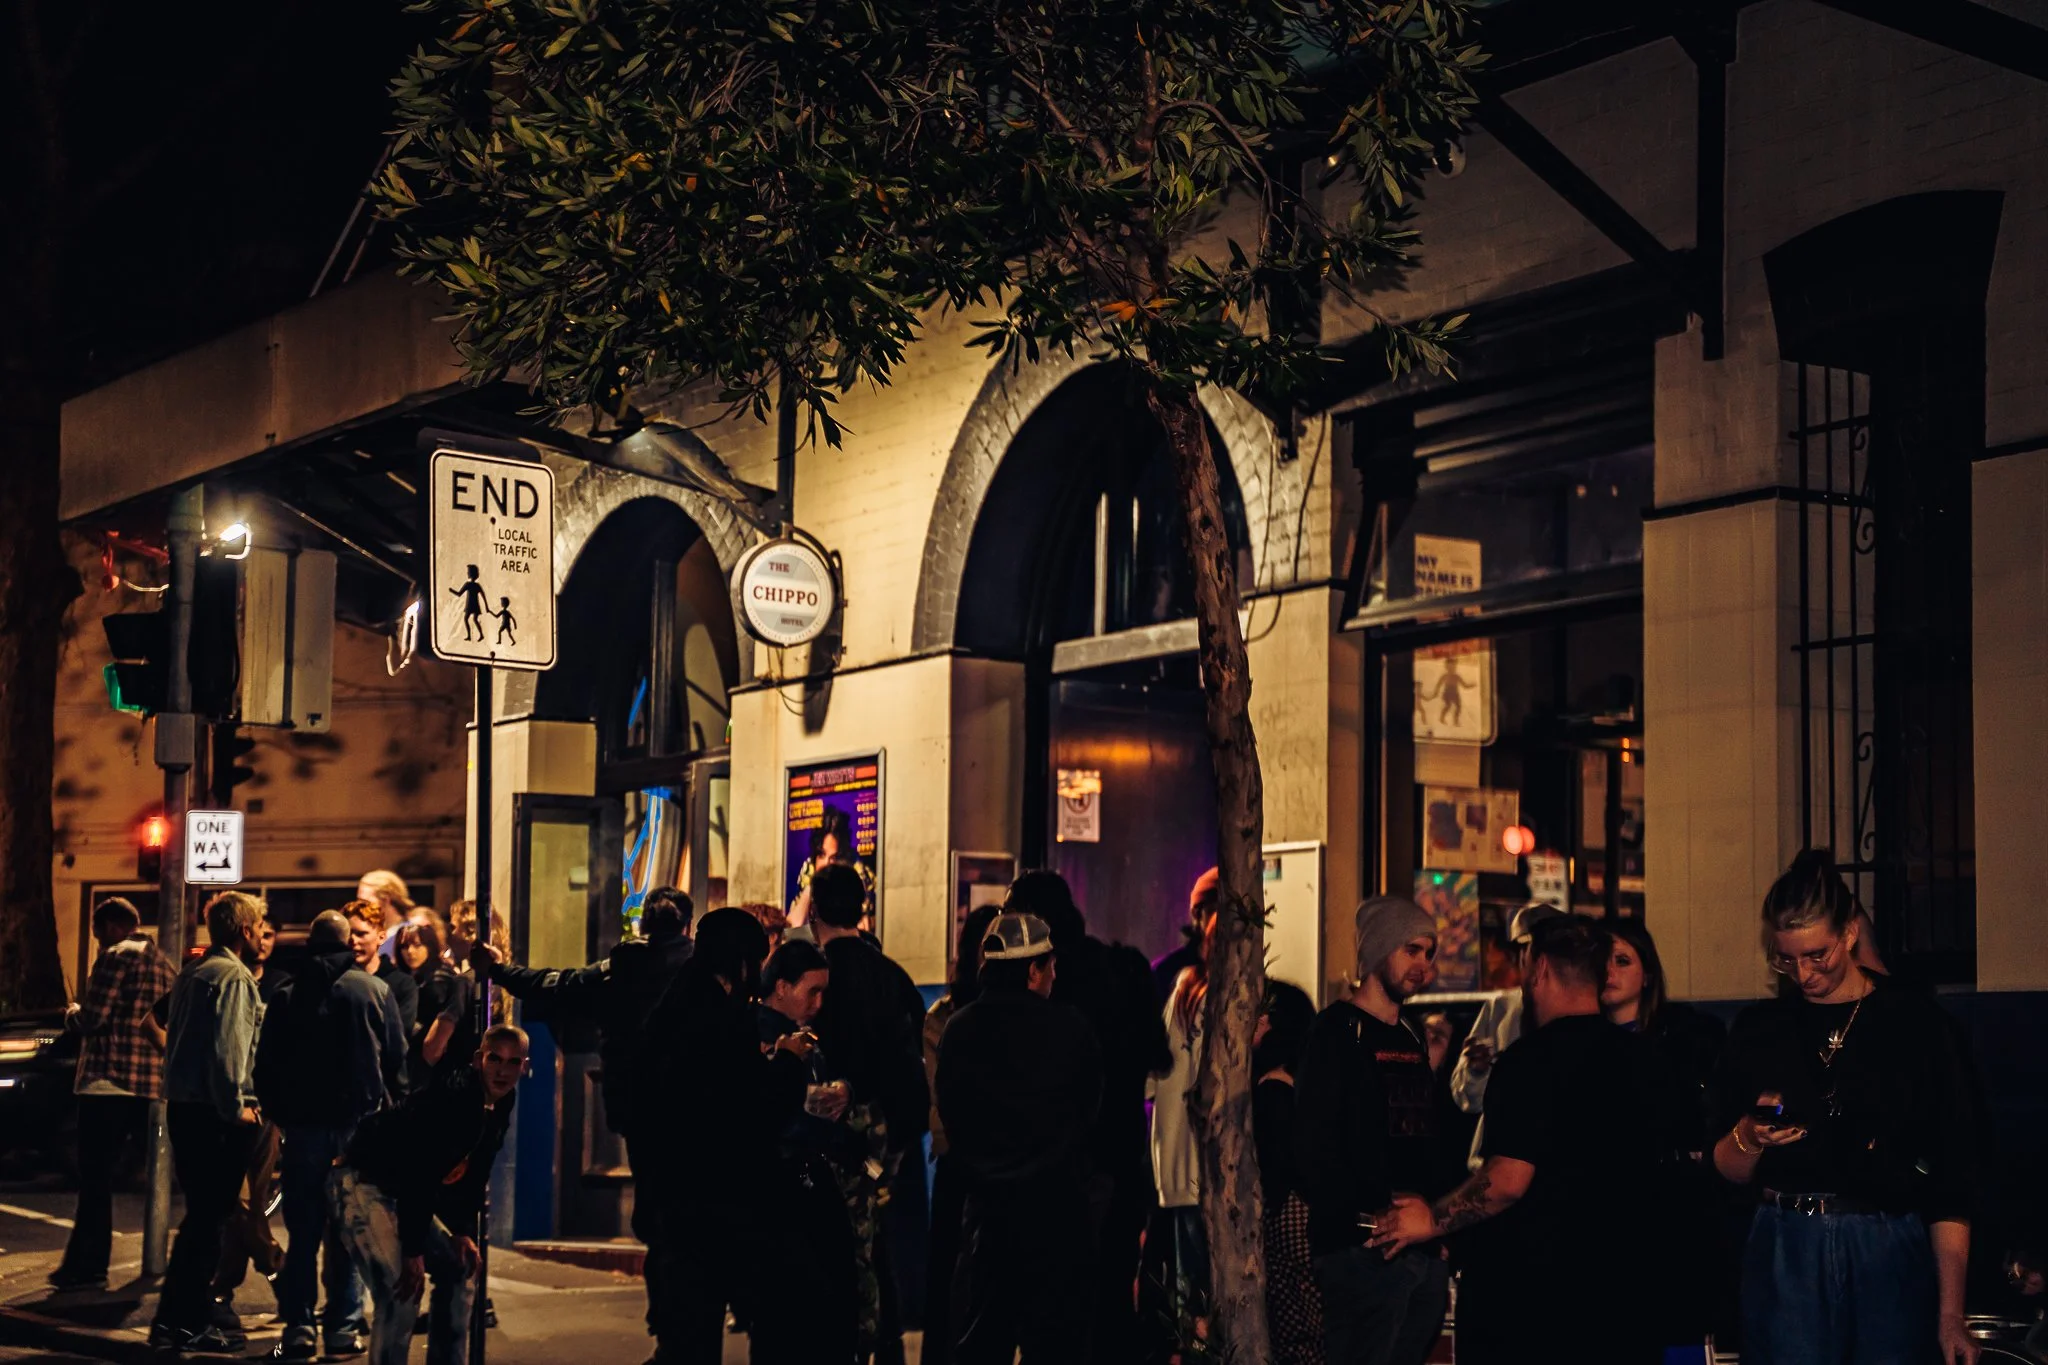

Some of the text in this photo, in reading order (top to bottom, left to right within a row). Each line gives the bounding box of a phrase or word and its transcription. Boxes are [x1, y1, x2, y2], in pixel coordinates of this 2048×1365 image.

[452, 470, 539, 518] END
[498, 528, 532, 543] LOCAL
[493, 543, 537, 559] TRAFFIC
[501, 560, 530, 573] AREA
[768, 561, 790, 573] THE
[753, 585, 818, 607] CHIPPO
[197, 820, 231, 834] ONE
[194, 841, 232, 855] WAY
